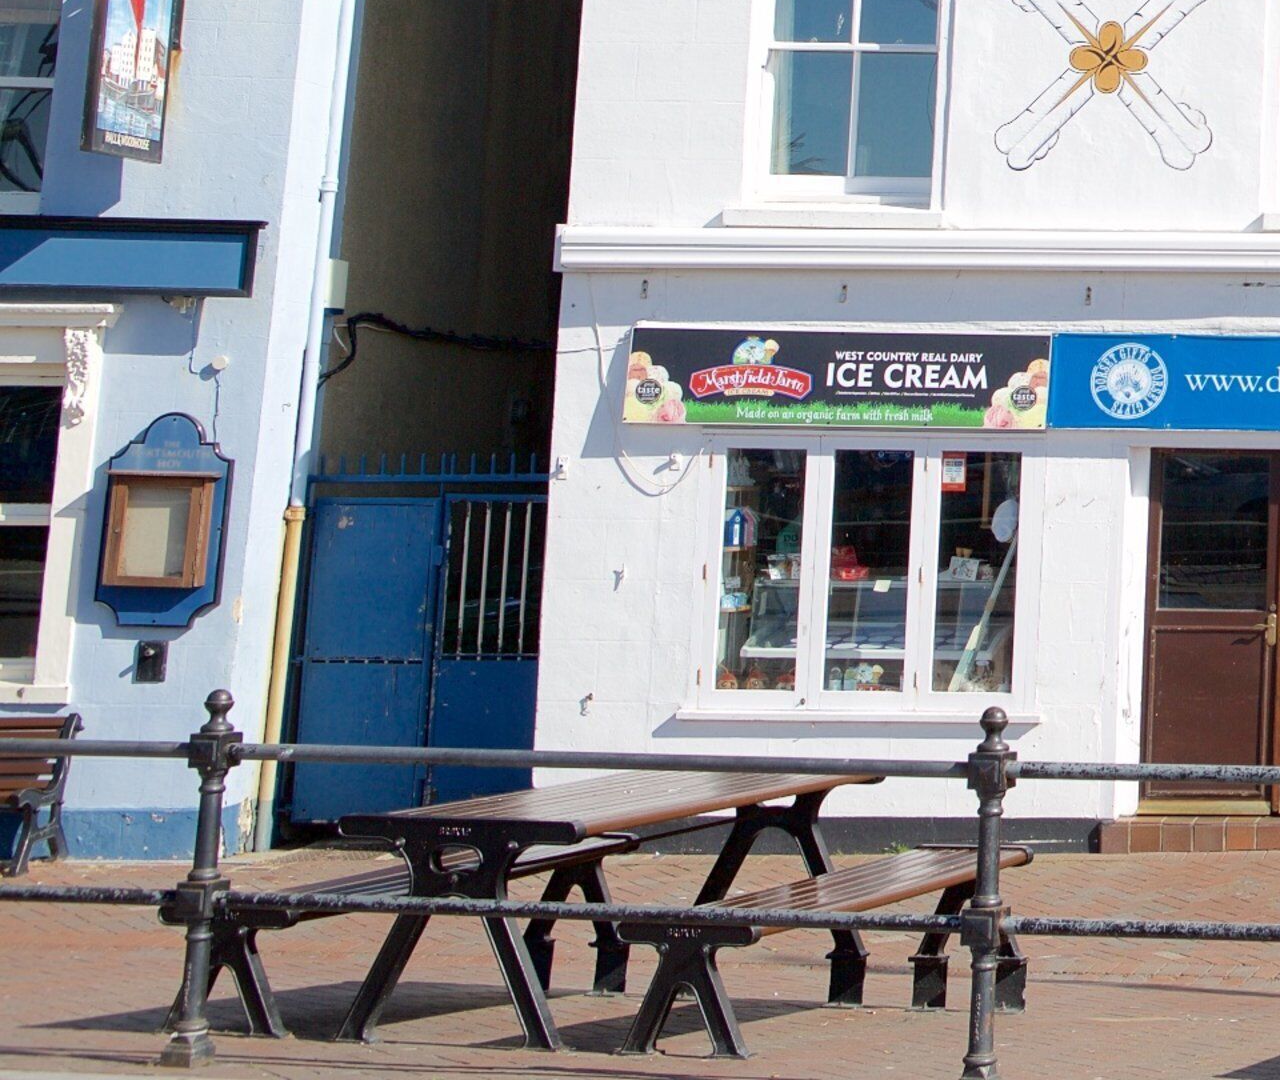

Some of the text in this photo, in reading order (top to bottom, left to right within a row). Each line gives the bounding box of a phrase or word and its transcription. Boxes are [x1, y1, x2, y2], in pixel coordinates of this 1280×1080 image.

[835, 351, 983, 364] WEST COUNTRY REAL DAIRY
[826, 362, 988, 390] ICE CREAM
[1094, 347, 1152, 393] DORSET GIFTS
[637, 385, 660, 394] taste
[698, 370, 770, 393] Marshfield
[1013, 393, 1036, 401] taste
[736, 407, 933, 424] Made on an organic farm with fresh milk
